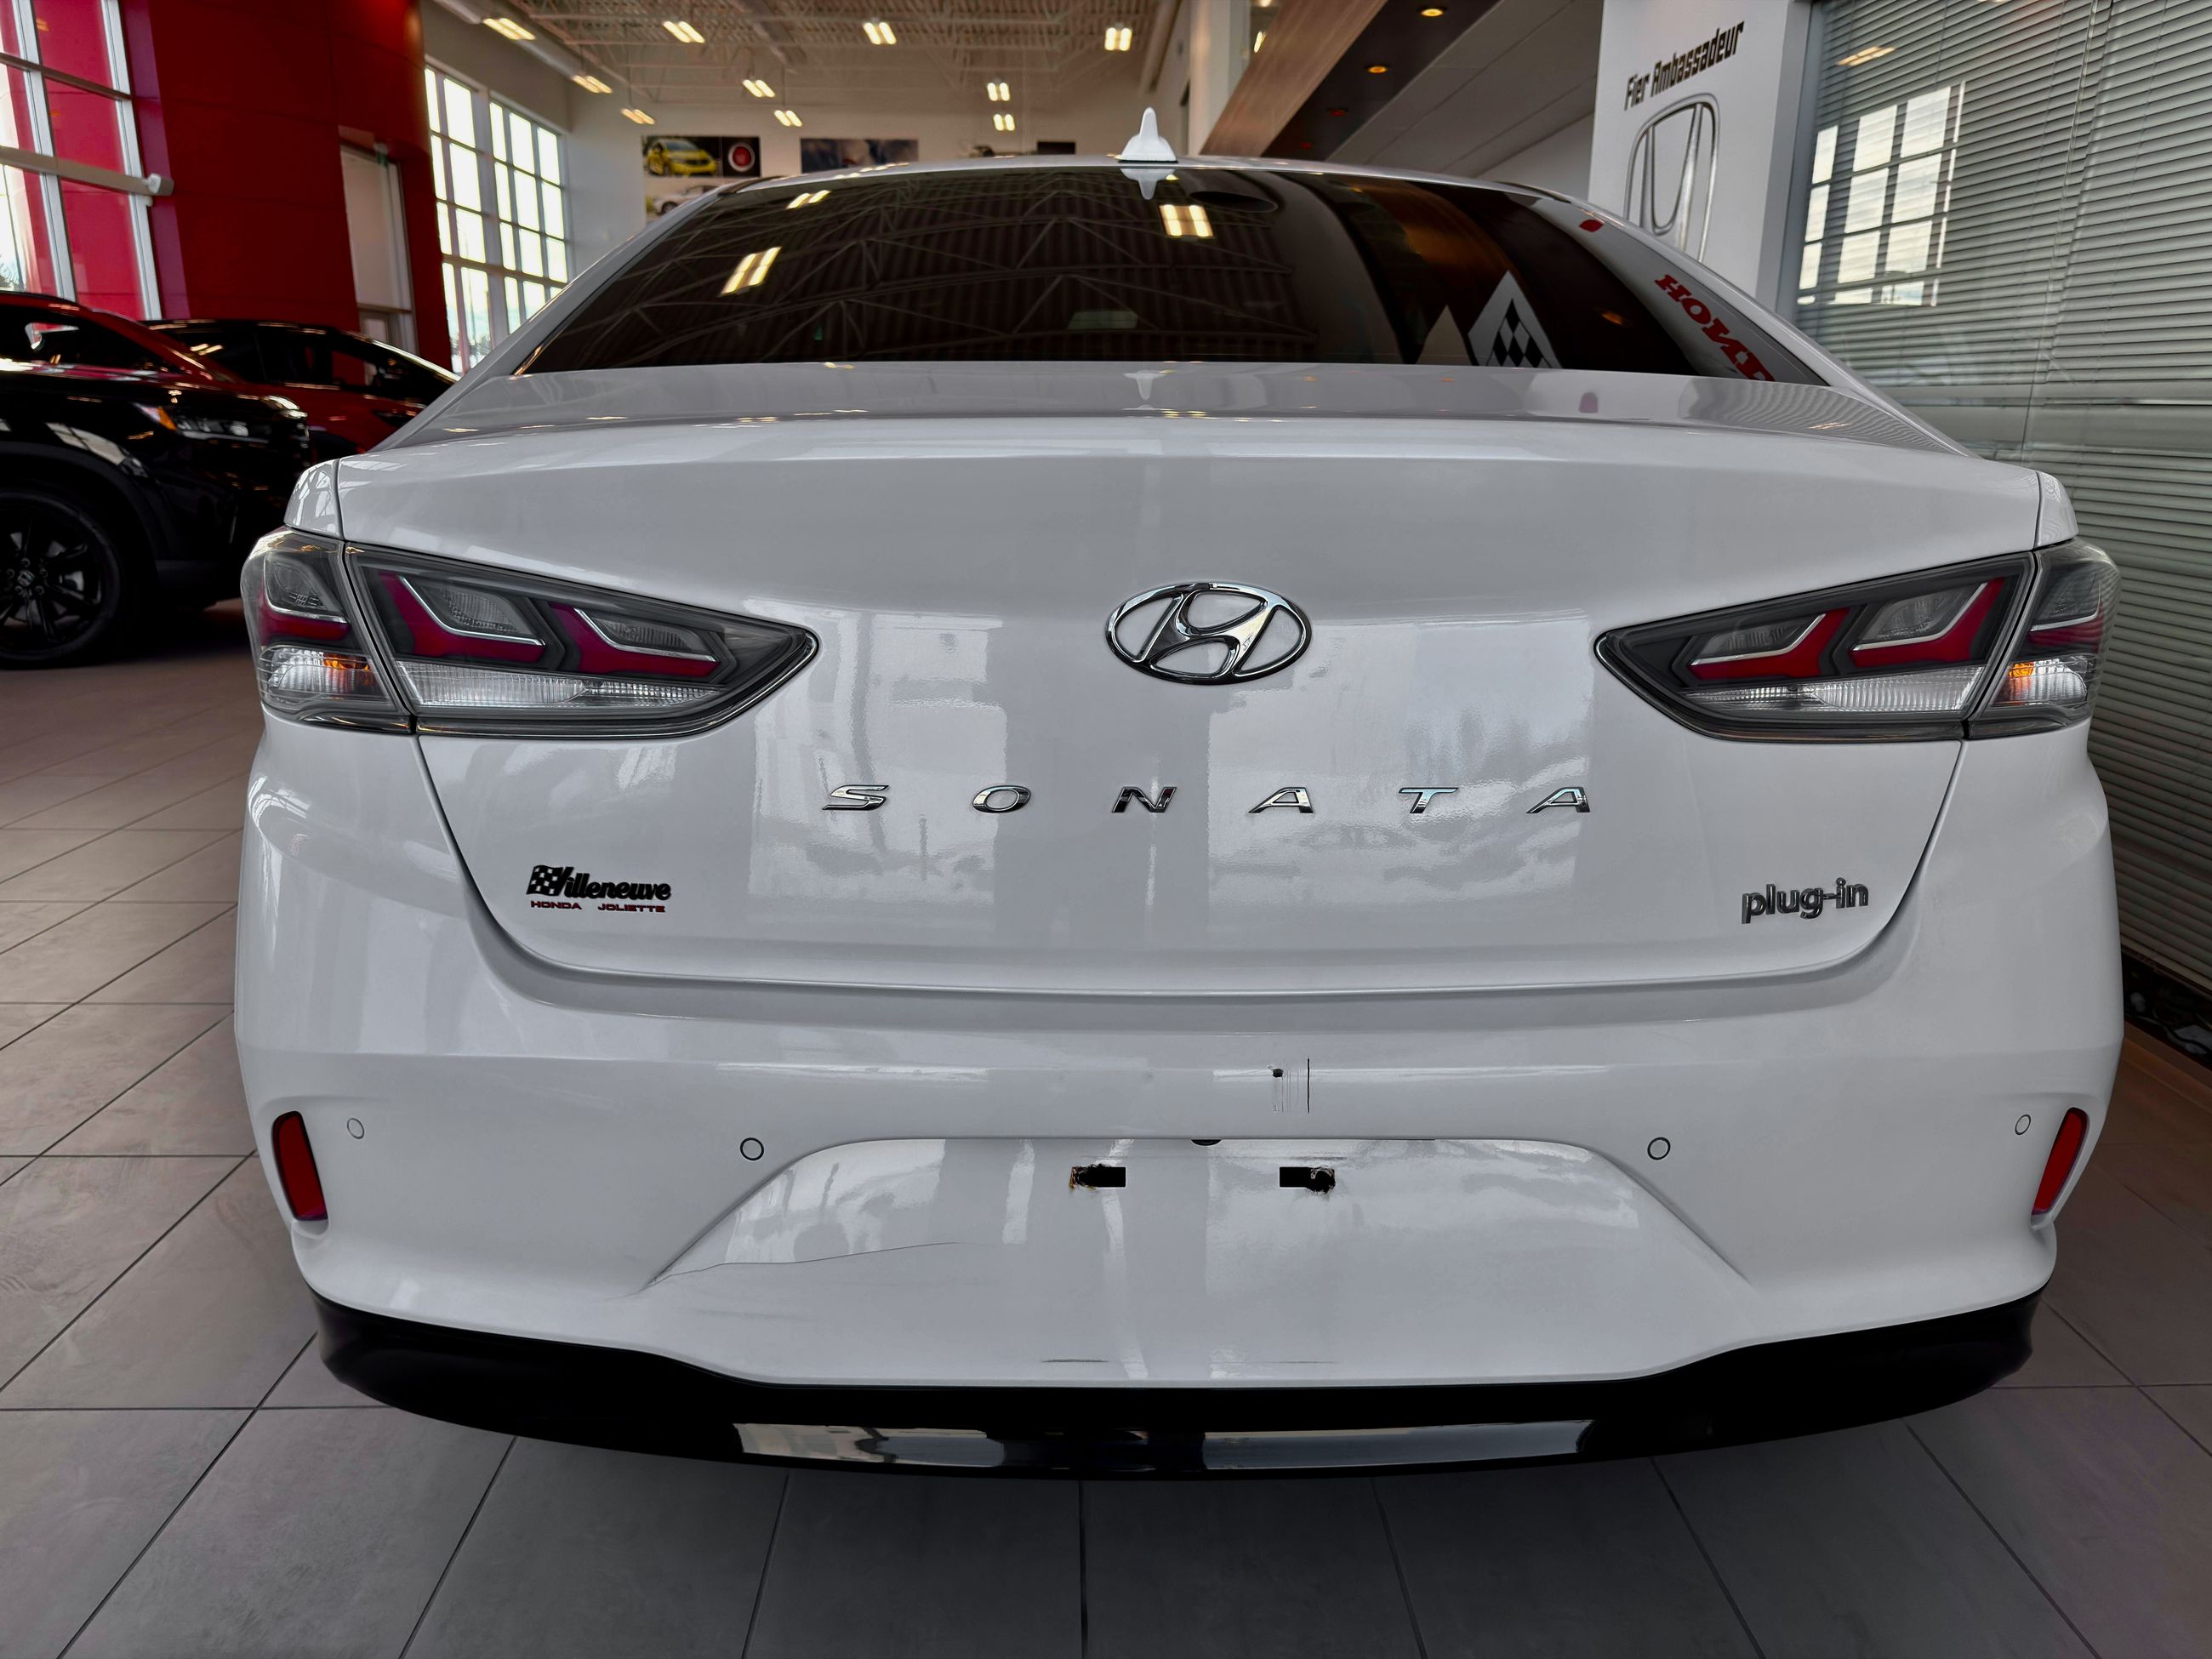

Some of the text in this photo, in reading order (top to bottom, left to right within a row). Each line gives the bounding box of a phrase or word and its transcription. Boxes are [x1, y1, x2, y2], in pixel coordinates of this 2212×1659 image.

[1624, 20, 1745, 111] Fier Ambassadeur
[822, 784, 1591, 814] SONATA
[550, 866, 672, 901] Villeneuve
[1742, 877, 1869, 924] plug-in
[530, 900, 666, 913] HONDA JOLIETTE
